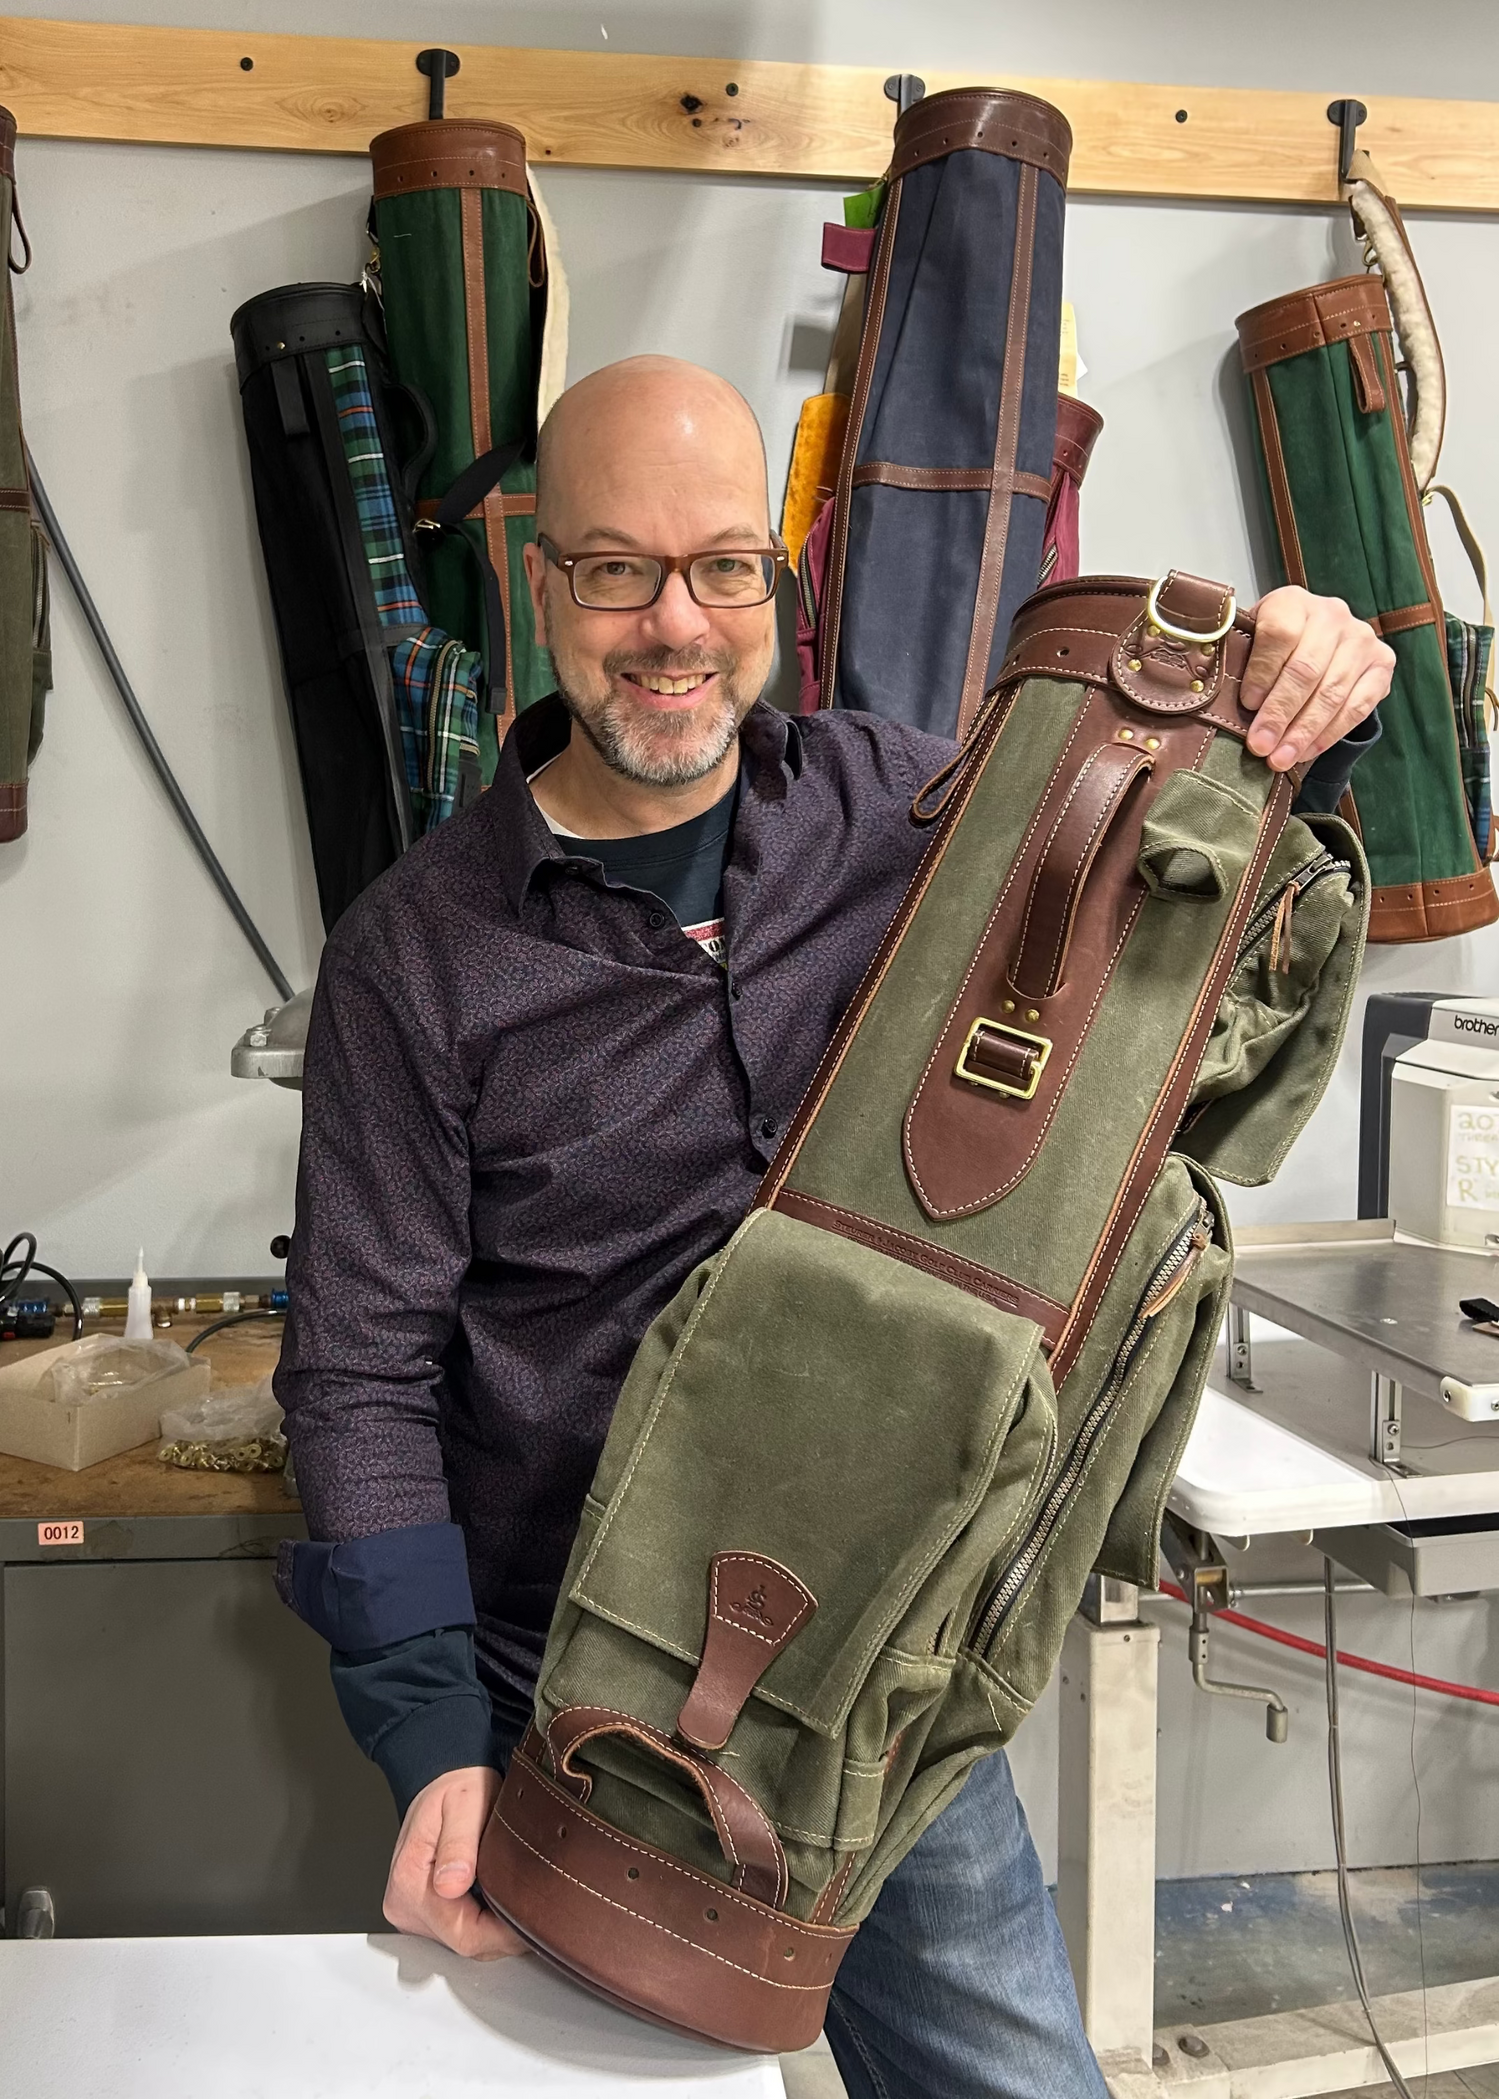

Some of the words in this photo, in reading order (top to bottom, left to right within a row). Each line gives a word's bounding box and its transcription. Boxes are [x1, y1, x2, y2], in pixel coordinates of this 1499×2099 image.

[1454, 1014, 1499, 1036] brother
[919, 1253, 946, 1270] GOLF
[946, 1265, 972, 1281] CLUB
[971, 1276, 1021, 1304] CARRIERS
[44, 1525, 79, 1540] 0012
